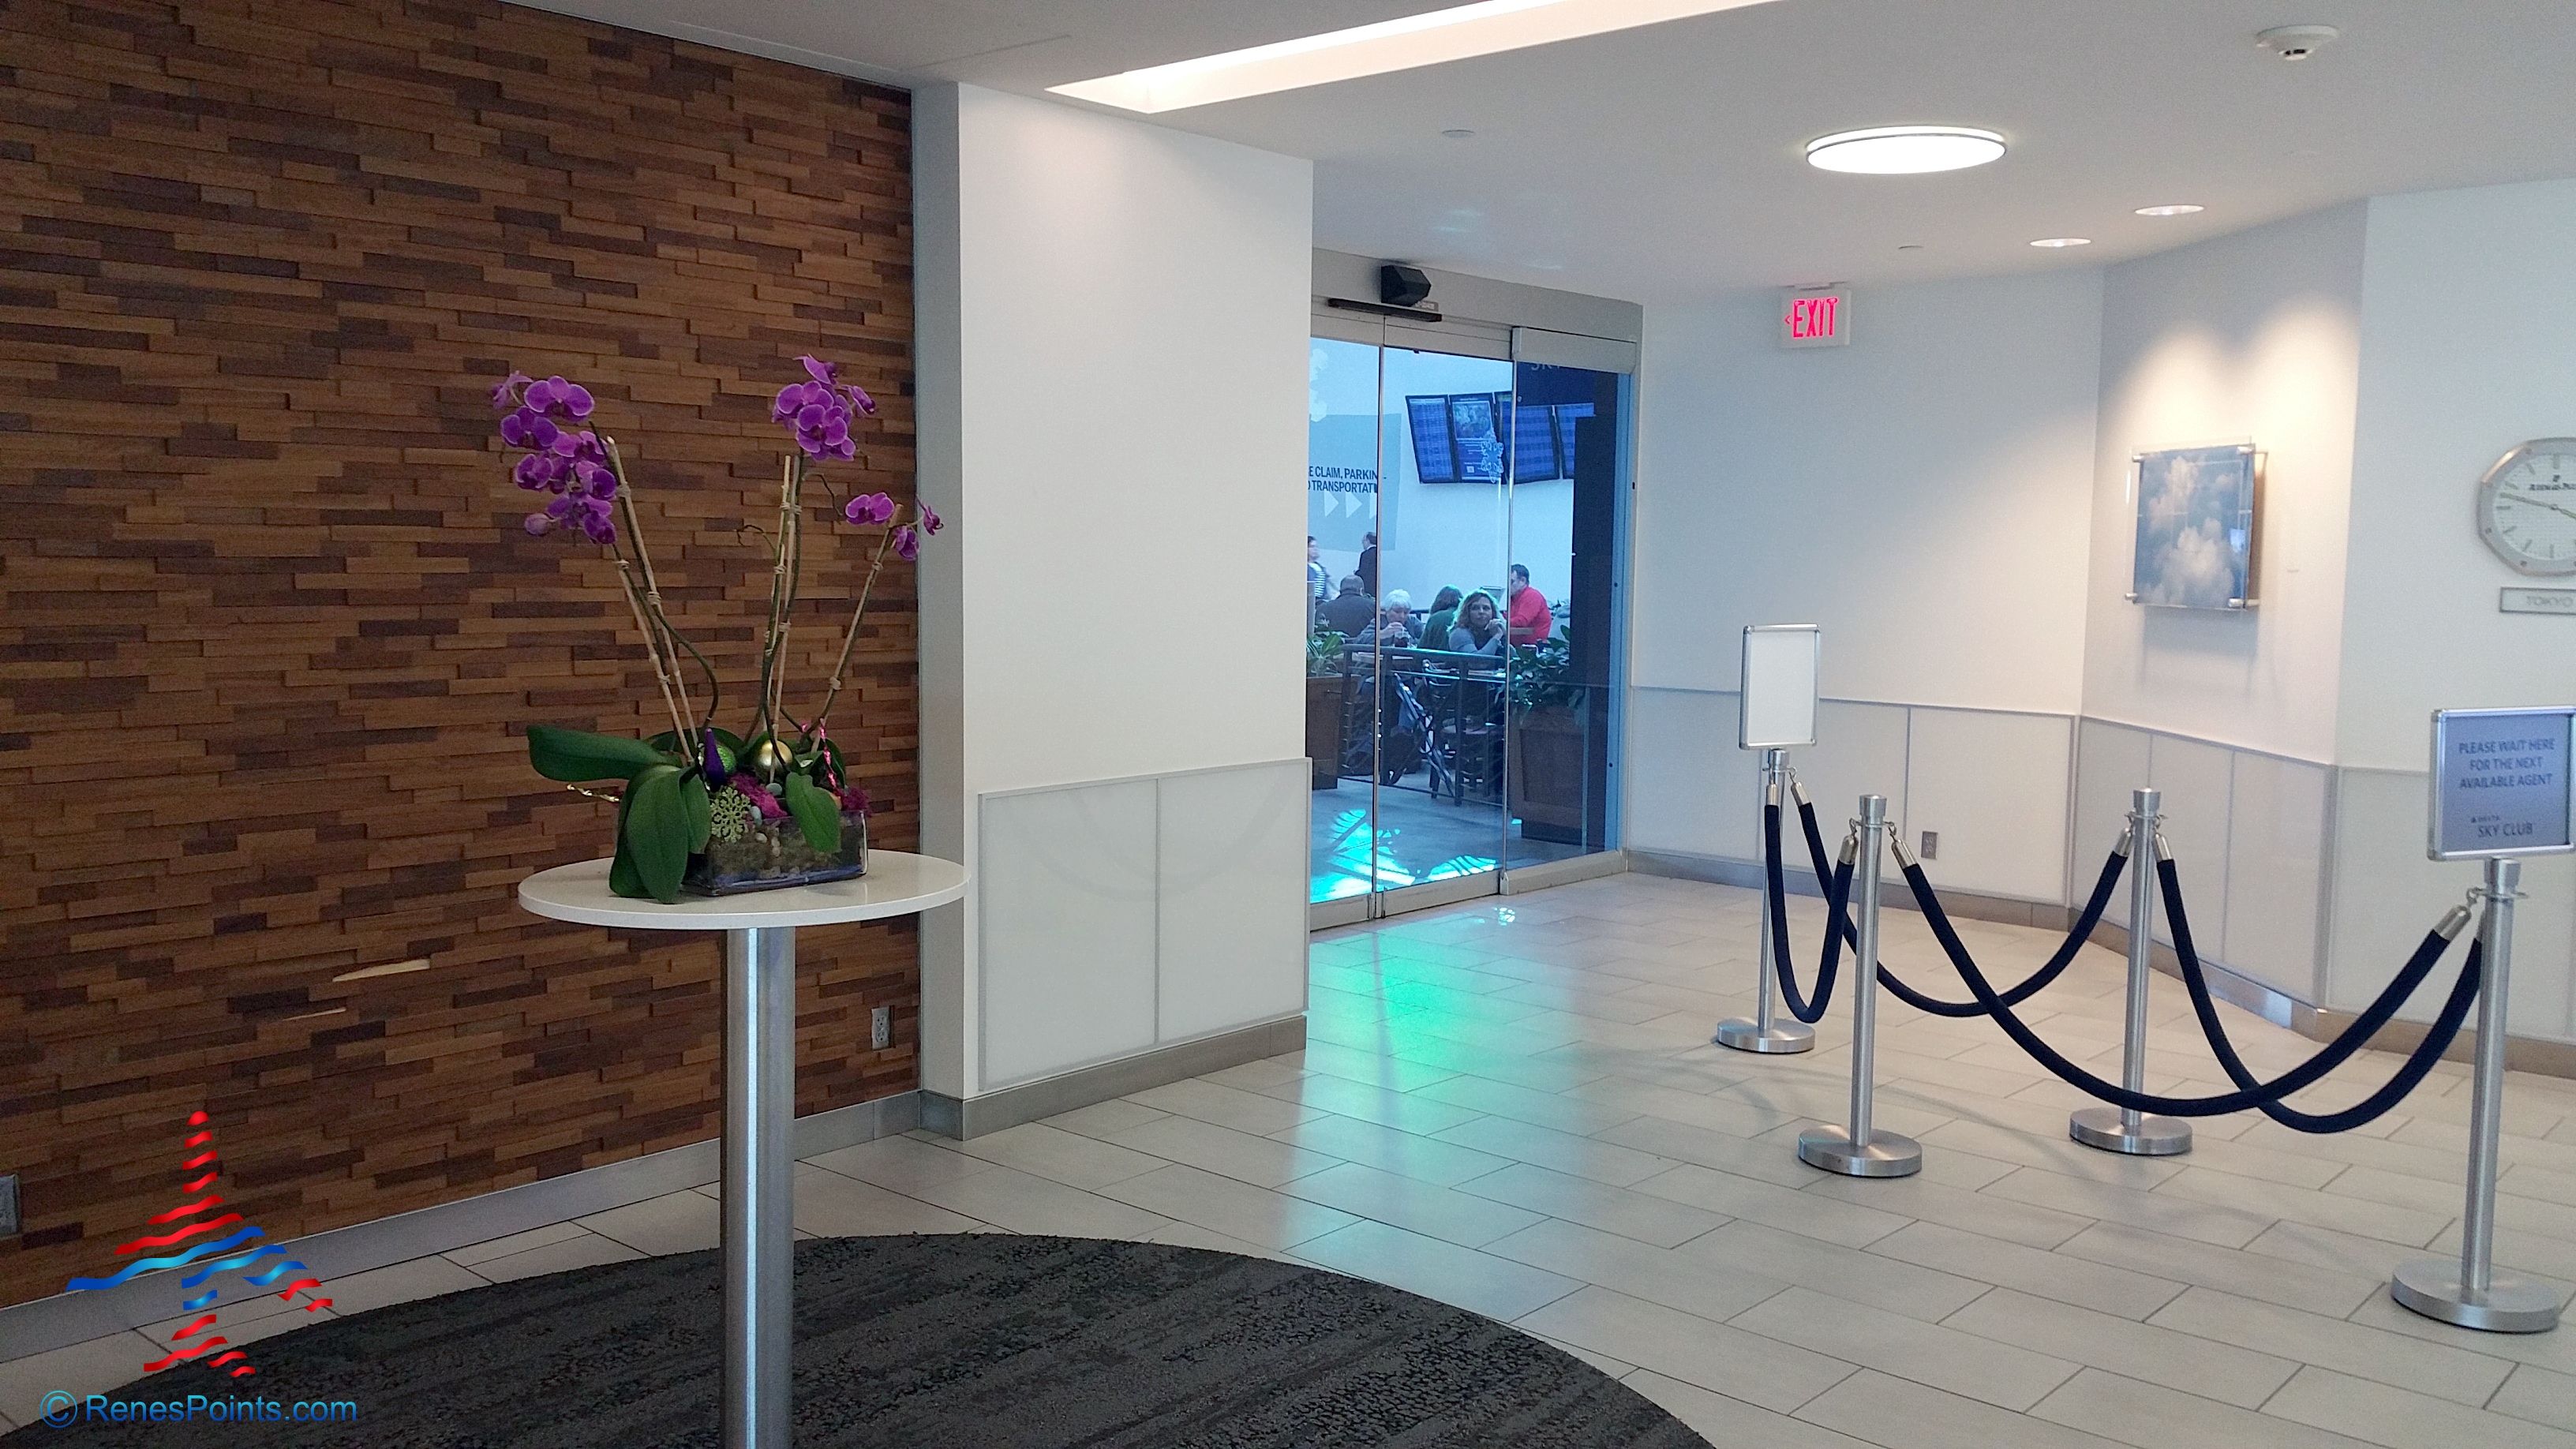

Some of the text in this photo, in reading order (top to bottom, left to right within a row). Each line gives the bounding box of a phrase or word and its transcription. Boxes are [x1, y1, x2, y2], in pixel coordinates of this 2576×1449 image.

[1792, 298, 1838, 338] EXIT
[1315, 466, 1343, 479] CLAIM,
[1312, 480, 1378, 493] TRANSPORTATI
[2458, 738, 2555, 754] PLEASE WAIT HERE
[2469, 756, 2543, 771] FOR THE NEXT
[2459, 773, 2553, 788] AVAILABLE AGENT
[2478, 822, 2533, 837] SKY CLUB
